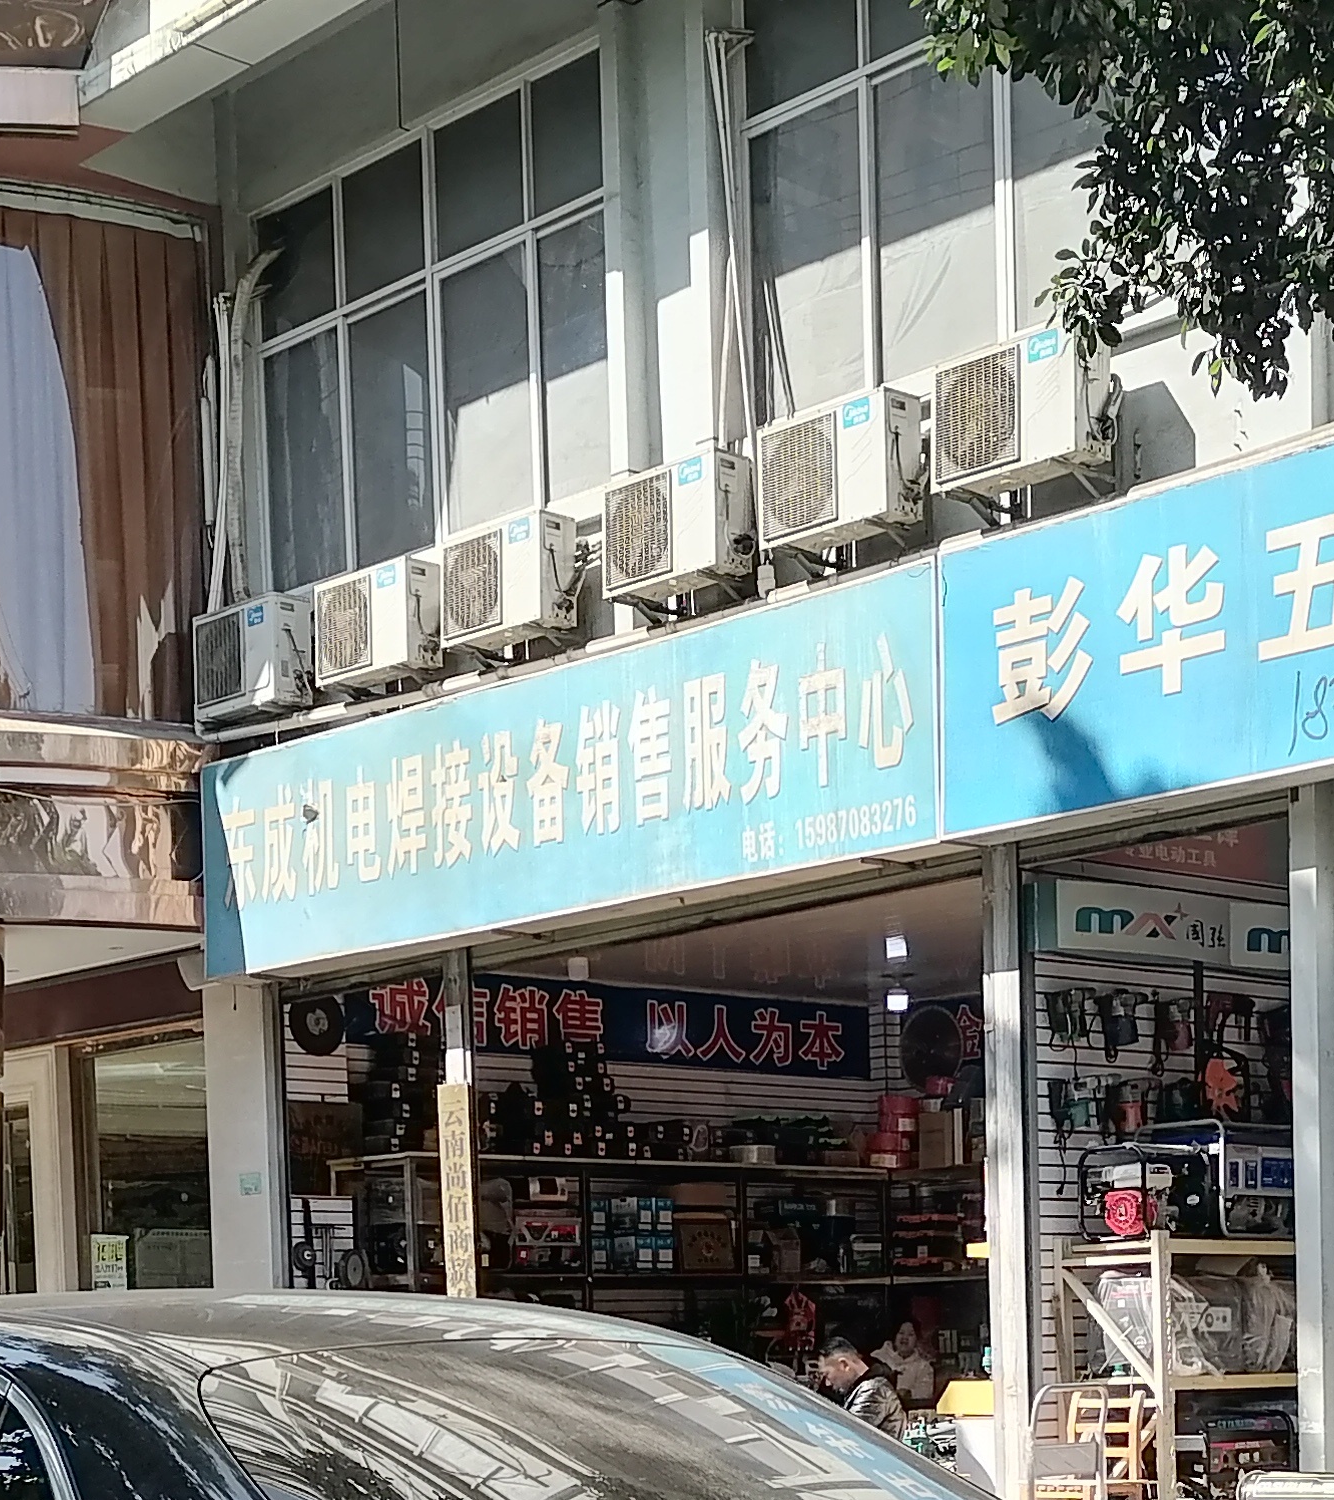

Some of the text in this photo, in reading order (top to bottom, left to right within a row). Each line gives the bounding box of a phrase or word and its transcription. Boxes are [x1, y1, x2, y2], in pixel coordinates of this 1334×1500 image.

[218, 633, 914, 911] 东成机电焊接设备销售服务中心
[646, 999, 845, 1070] 以人为本
